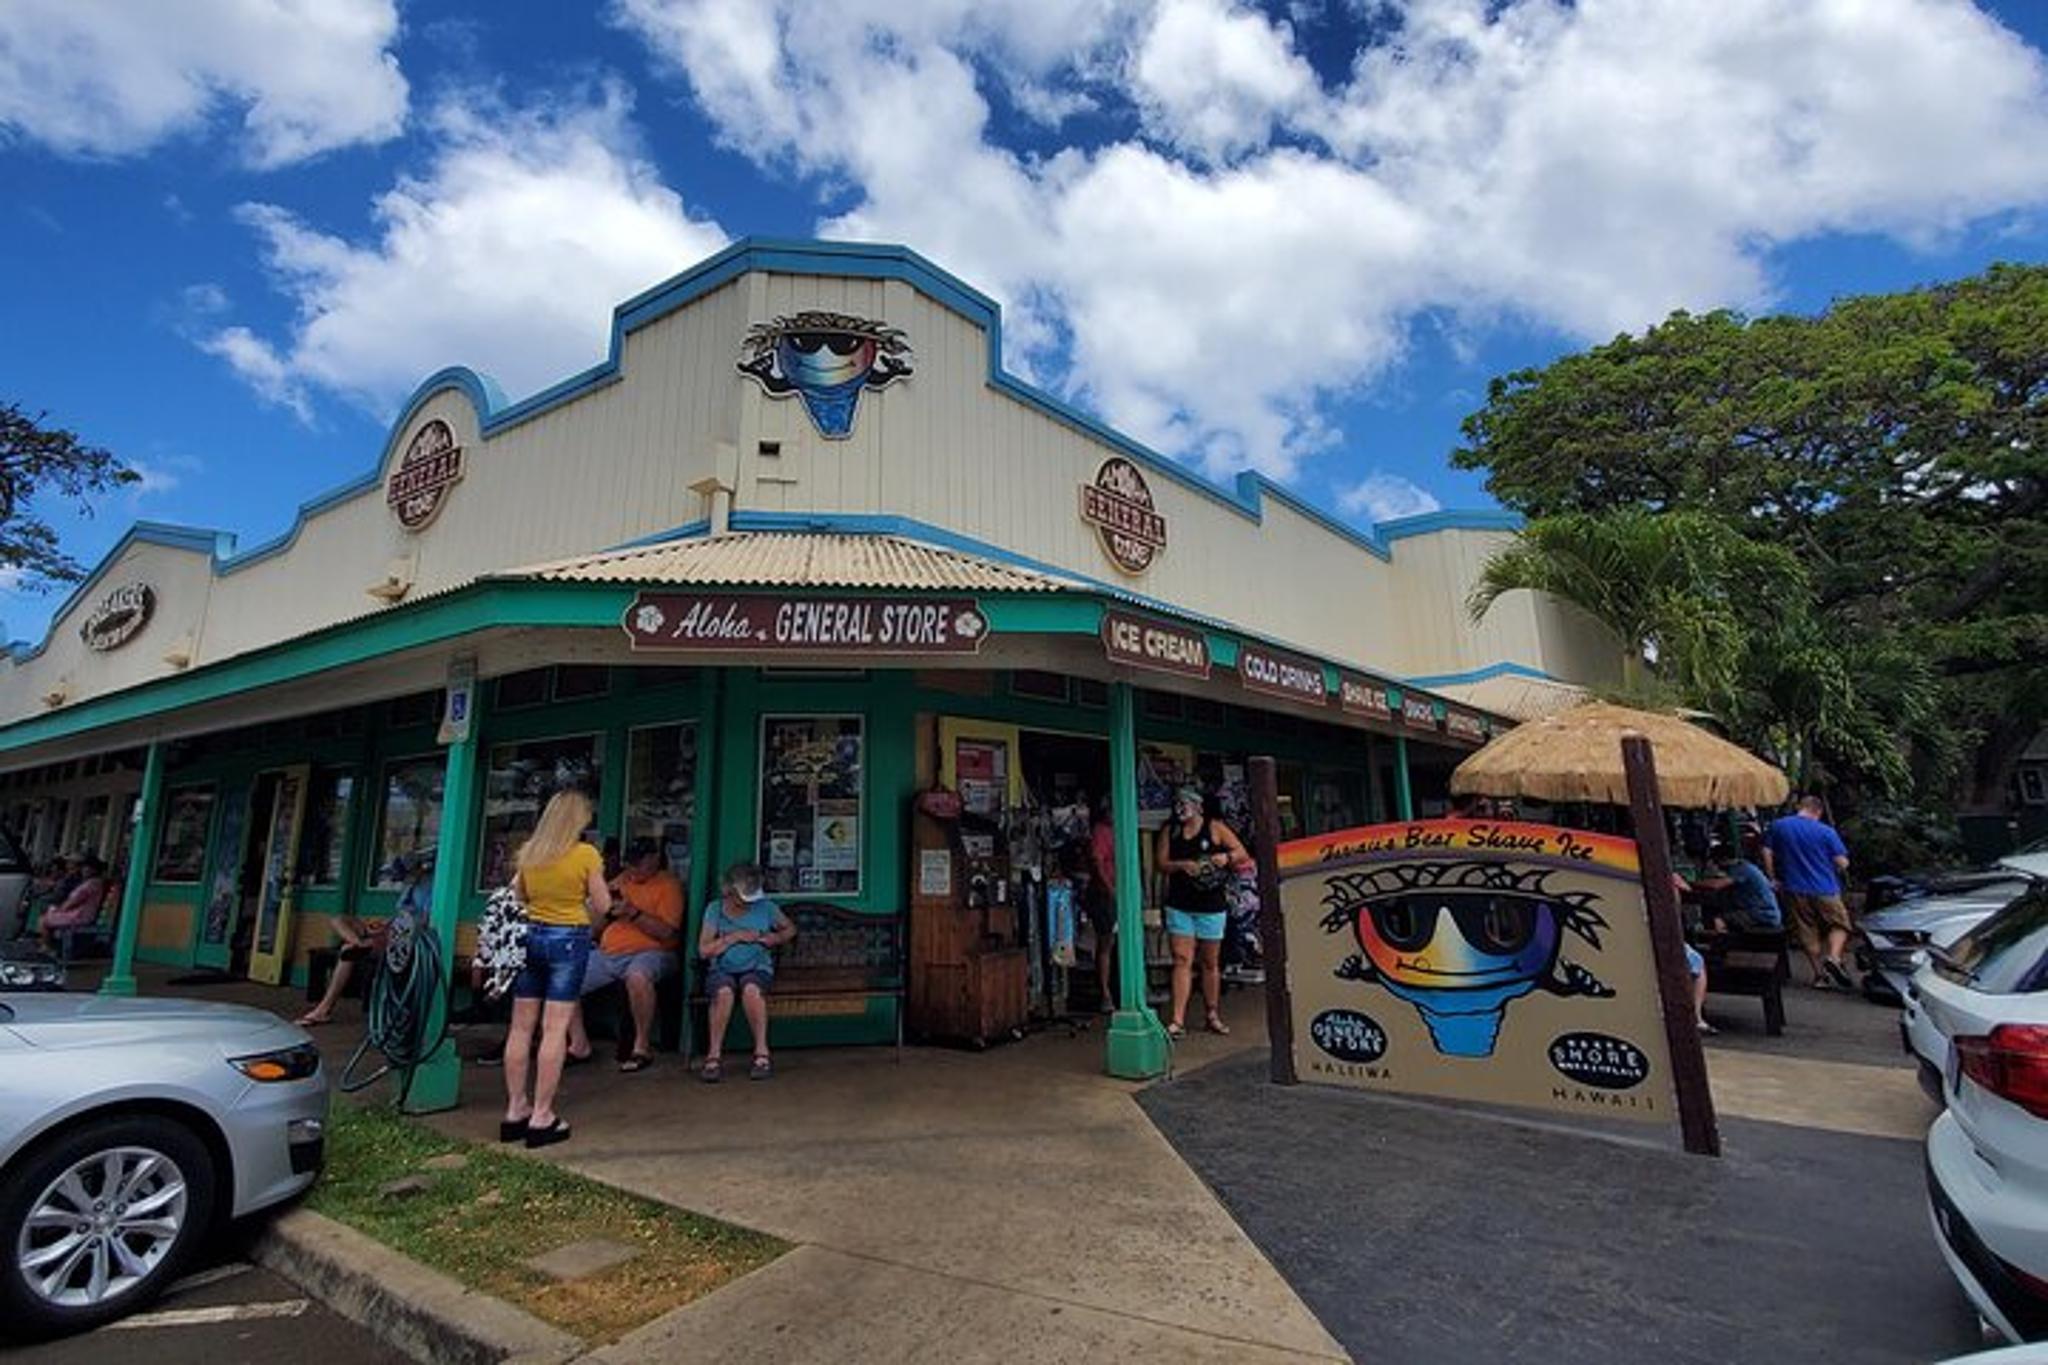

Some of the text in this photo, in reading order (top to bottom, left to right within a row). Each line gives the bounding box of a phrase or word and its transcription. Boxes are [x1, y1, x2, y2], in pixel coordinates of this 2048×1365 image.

[672, 601, 950, 644] Aloha GENERAL STORE
[1111, 619, 1205, 666] ICE CREAM
[1245, 653, 1324, 695] COLD DRINKS
[1405, 826, 1455, 848] Best
[1467, 824, 1545, 853] Shave
[1556, 832, 1594, 861] Ice
[1322, 1036, 1383, 1054] STORE
[1553, 1046, 1639, 1068] SHORE
[1552, 1087, 1654, 1111] HAWAII
